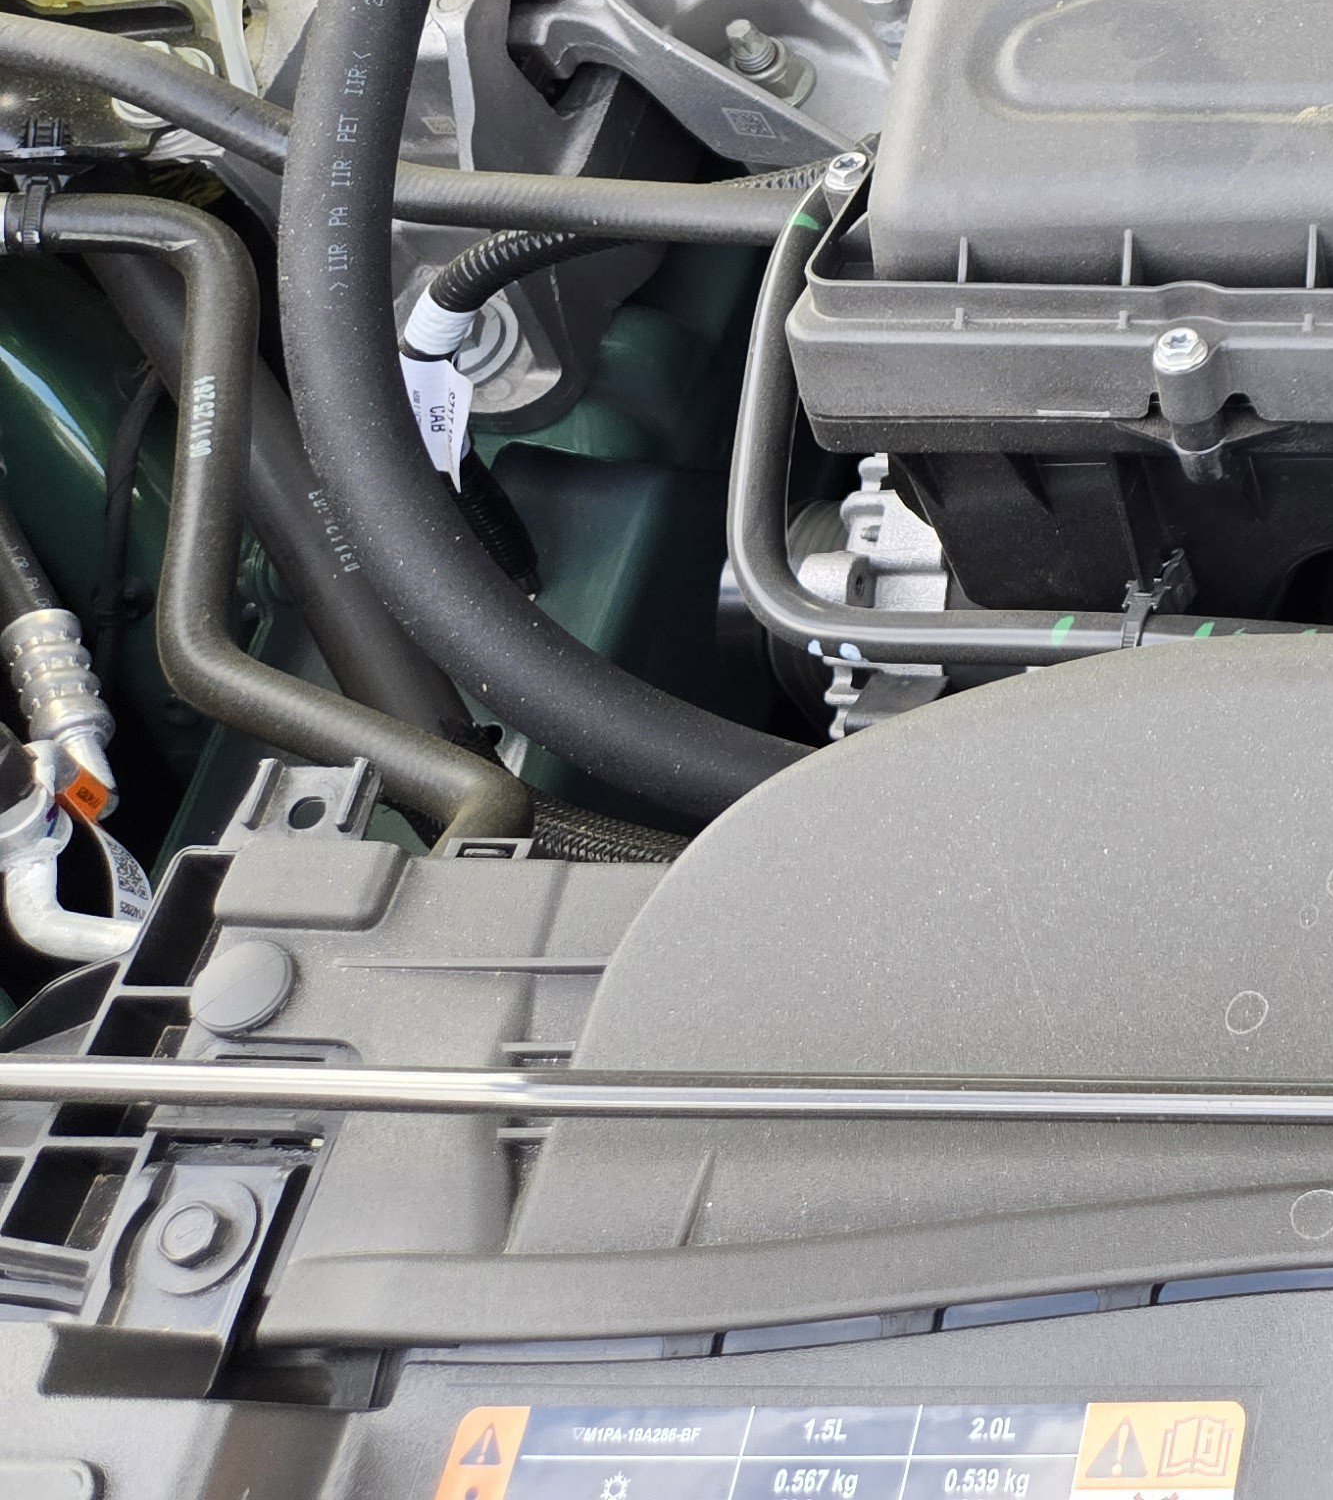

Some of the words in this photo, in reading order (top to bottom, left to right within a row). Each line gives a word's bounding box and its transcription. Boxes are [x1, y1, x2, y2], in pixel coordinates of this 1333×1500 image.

[335, 112, 361, 144] PET
[331, 157, 355, 189] IIR
[326, 203, 350, 228] PA
[426, 404, 450, 434] CAB
[803, 1416, 848, 1442] 1.5L
[968, 1416, 1017, 1442] 2.0L
[774, 1469, 825, 1495] 0.567
[828, 1469, 859, 1500] kg
[943, 1468, 994, 1494] 0.539
[997, 1469, 1031, 1499] kg
